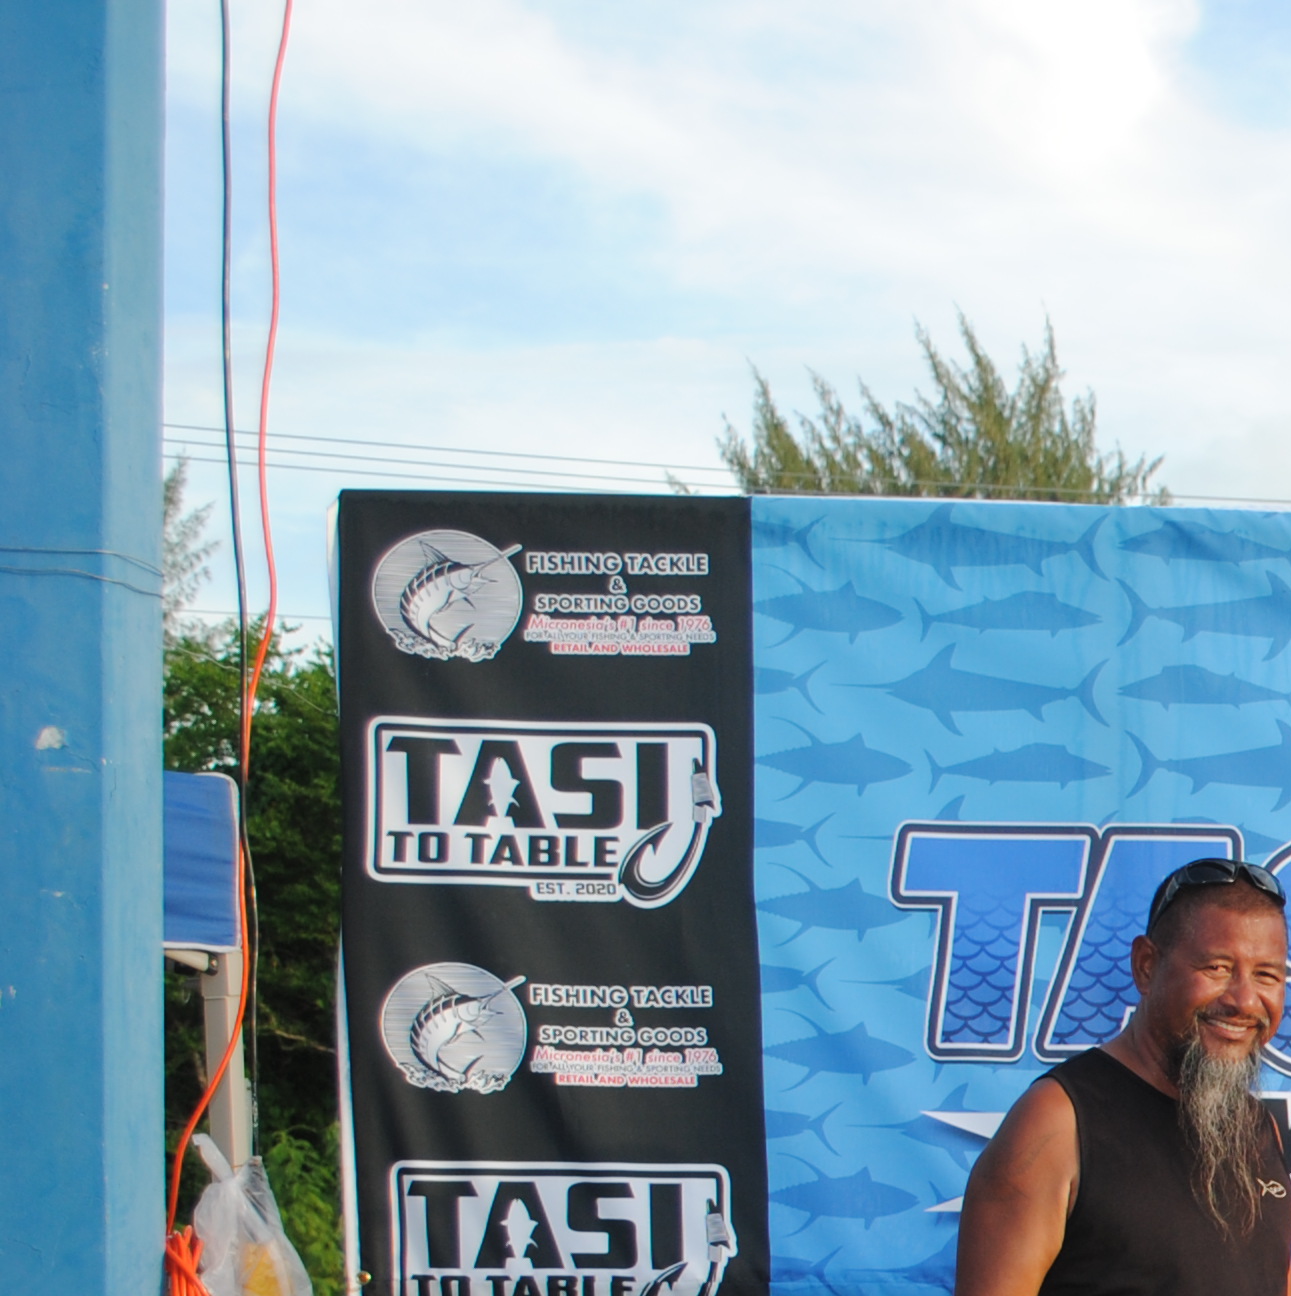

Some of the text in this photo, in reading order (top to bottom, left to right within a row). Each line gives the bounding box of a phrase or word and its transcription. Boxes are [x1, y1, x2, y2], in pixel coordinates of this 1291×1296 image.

[528, 554, 707, 573] FISHING TACKLE
[611, 577, 624, 591] &
[537, 596, 700, 611] SPORTING GOODS
[529, 616, 710, 630] Micronesia's #1 since 1976
[553, 644, 688, 653] RETAIL AND WHOLESALE
[386, 737, 668, 829] TASI
[387, 831, 620, 867] TO TABLE
[536, 882, 616, 895] EST. 2020
[532, 986, 711, 1006] FISHING TACKLE
[616, 1010, 631, 1024] &
[541, 1027, 706, 1044] SPORTING GOODS
[535, 1048, 716, 1063] Micronesia's #1 since 1976
[558, 1075, 695, 1085] RETAIL AND WHOLESALE
[407, 1181, 683, 1270] TASI
